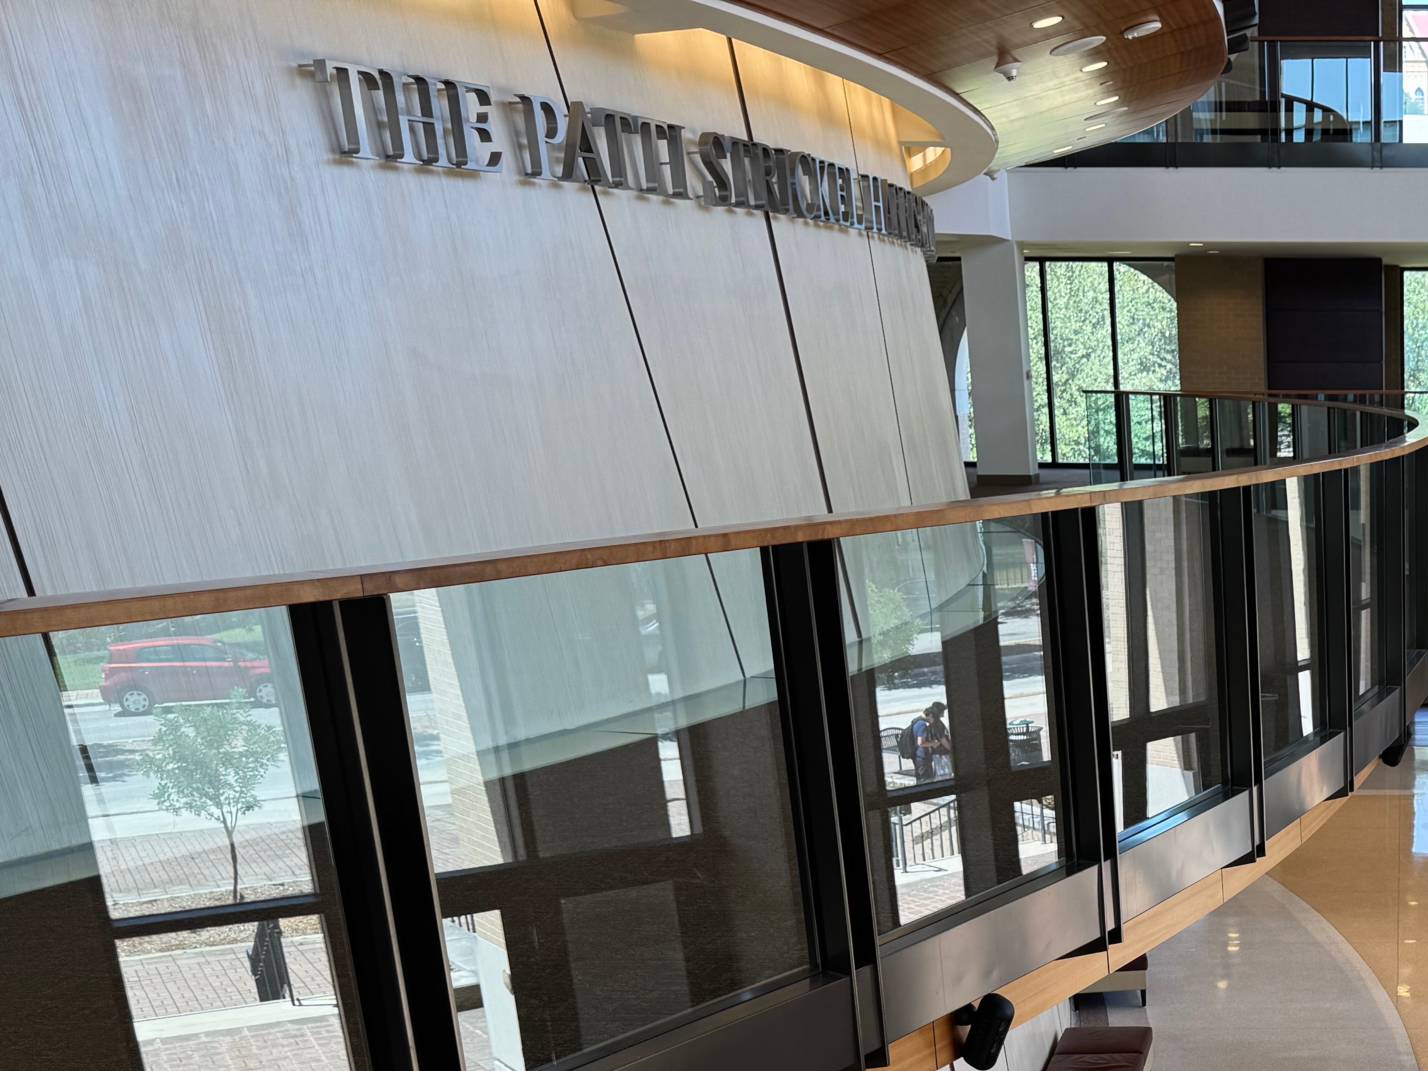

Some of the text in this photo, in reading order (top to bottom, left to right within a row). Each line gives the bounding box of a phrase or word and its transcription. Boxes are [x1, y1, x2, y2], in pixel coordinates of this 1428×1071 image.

[313, 59, 503, 173] THE
[514, 94, 693, 200] PATTI
[698, 132, 865, 230] STRICKEL
